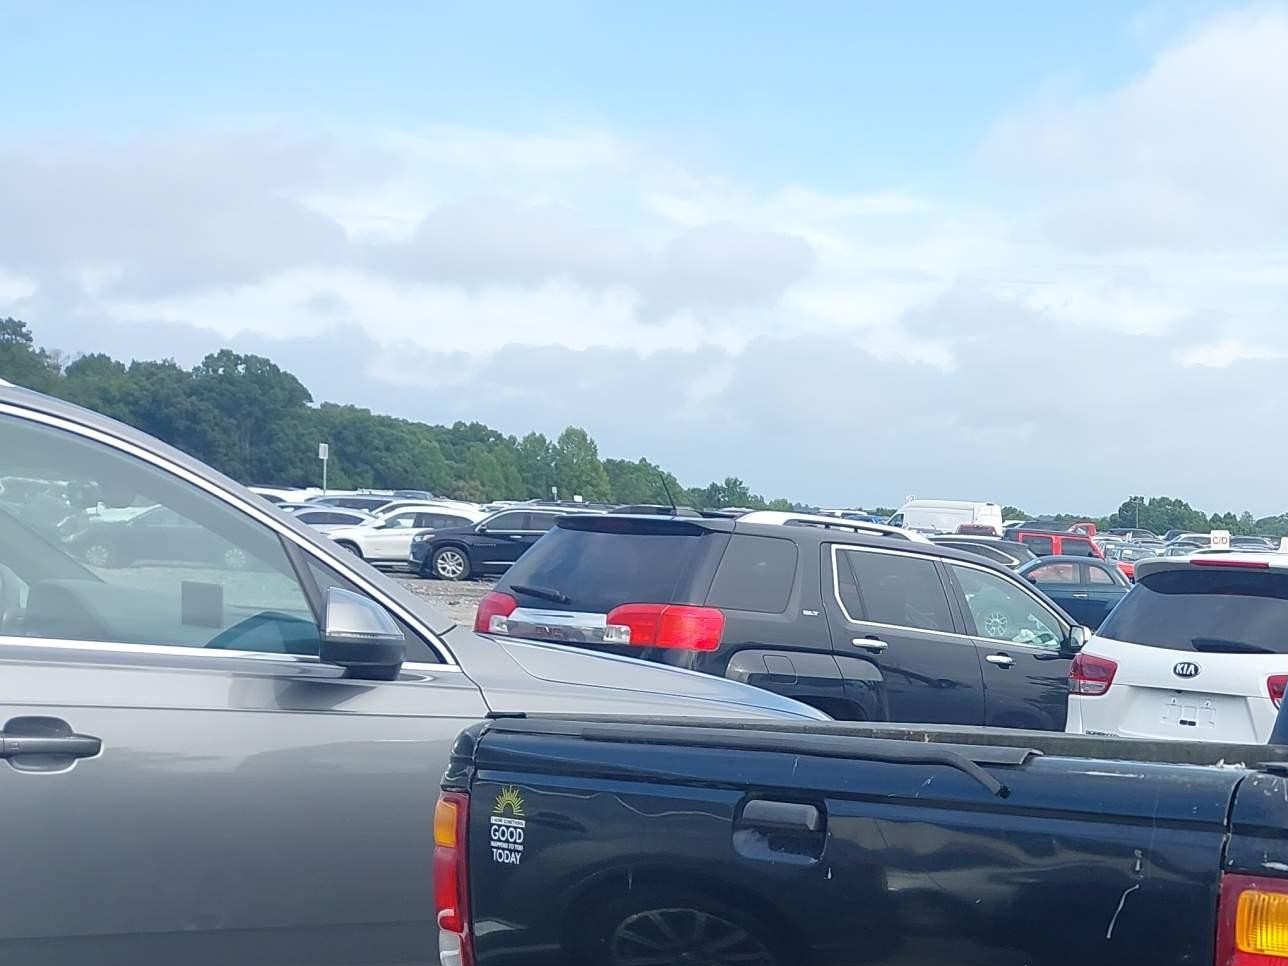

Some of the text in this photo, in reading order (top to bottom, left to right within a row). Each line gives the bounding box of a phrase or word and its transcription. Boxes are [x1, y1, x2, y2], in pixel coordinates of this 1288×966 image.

[1212, 536, 1228, 545] C/D
[1175, 663, 1195, 675] KIA
[490, 825, 524, 843] GOOD
[491, 848, 522, 865] TODAY
